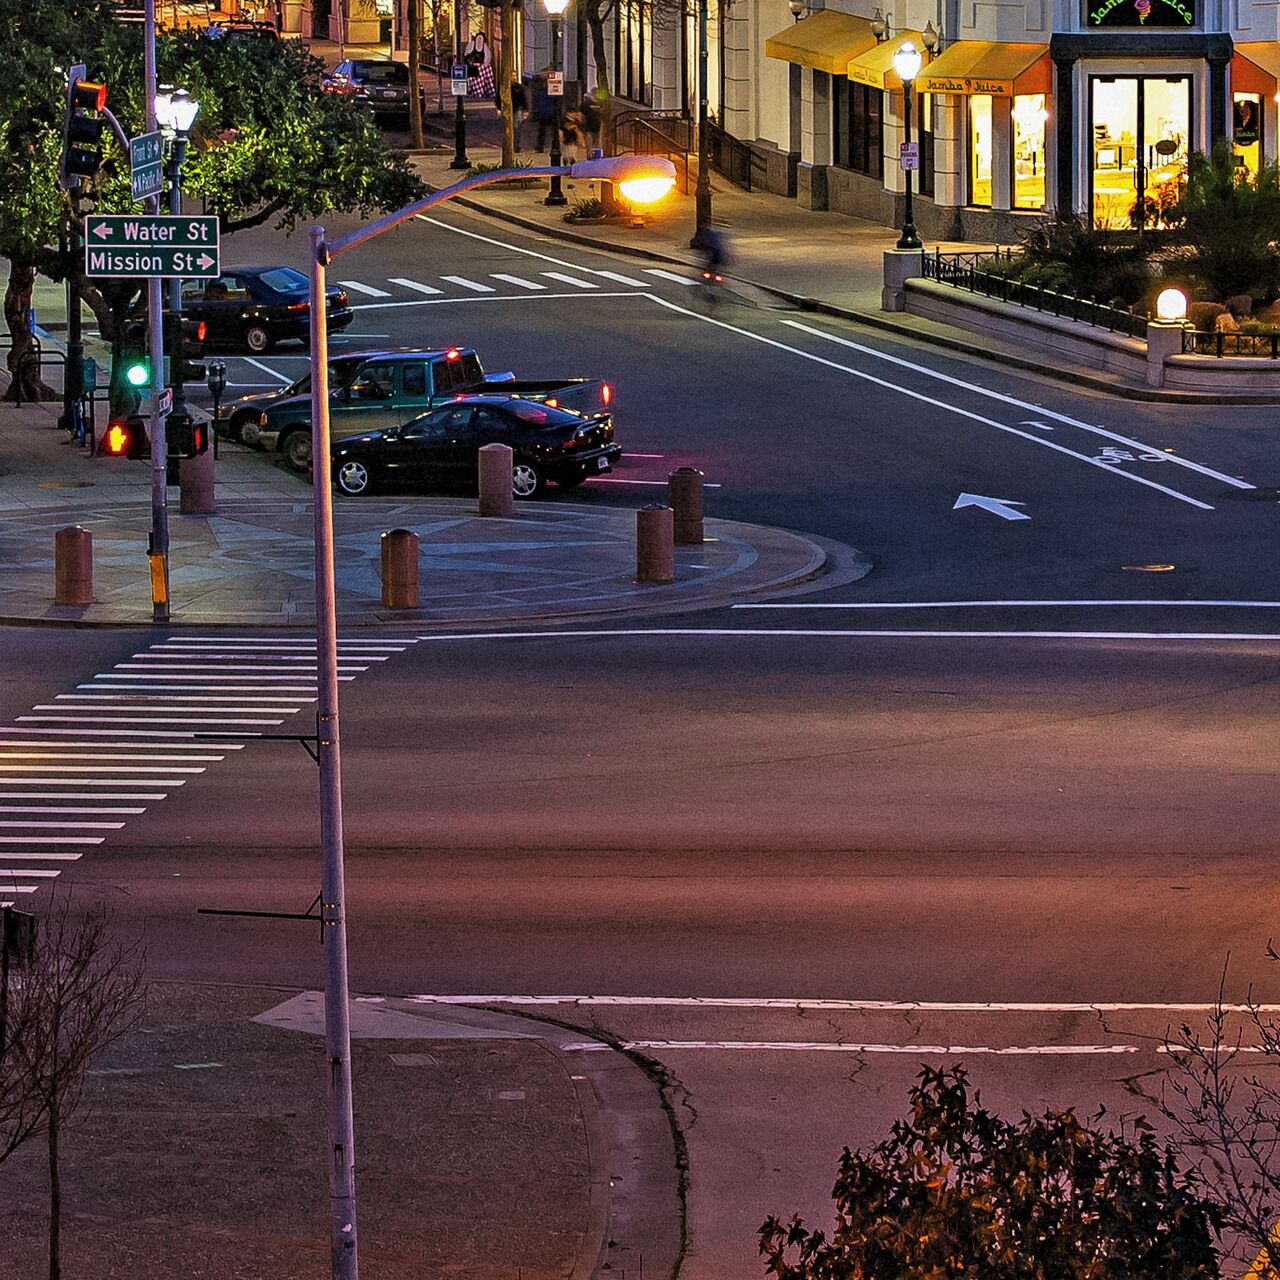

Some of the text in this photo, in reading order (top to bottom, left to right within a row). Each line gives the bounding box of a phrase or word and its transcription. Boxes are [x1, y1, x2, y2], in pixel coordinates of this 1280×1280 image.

[927, 80, 1004, 92] Jamba Juice
[123, 222, 209, 241] Water St
[90, 252, 194, 271] Mission St
